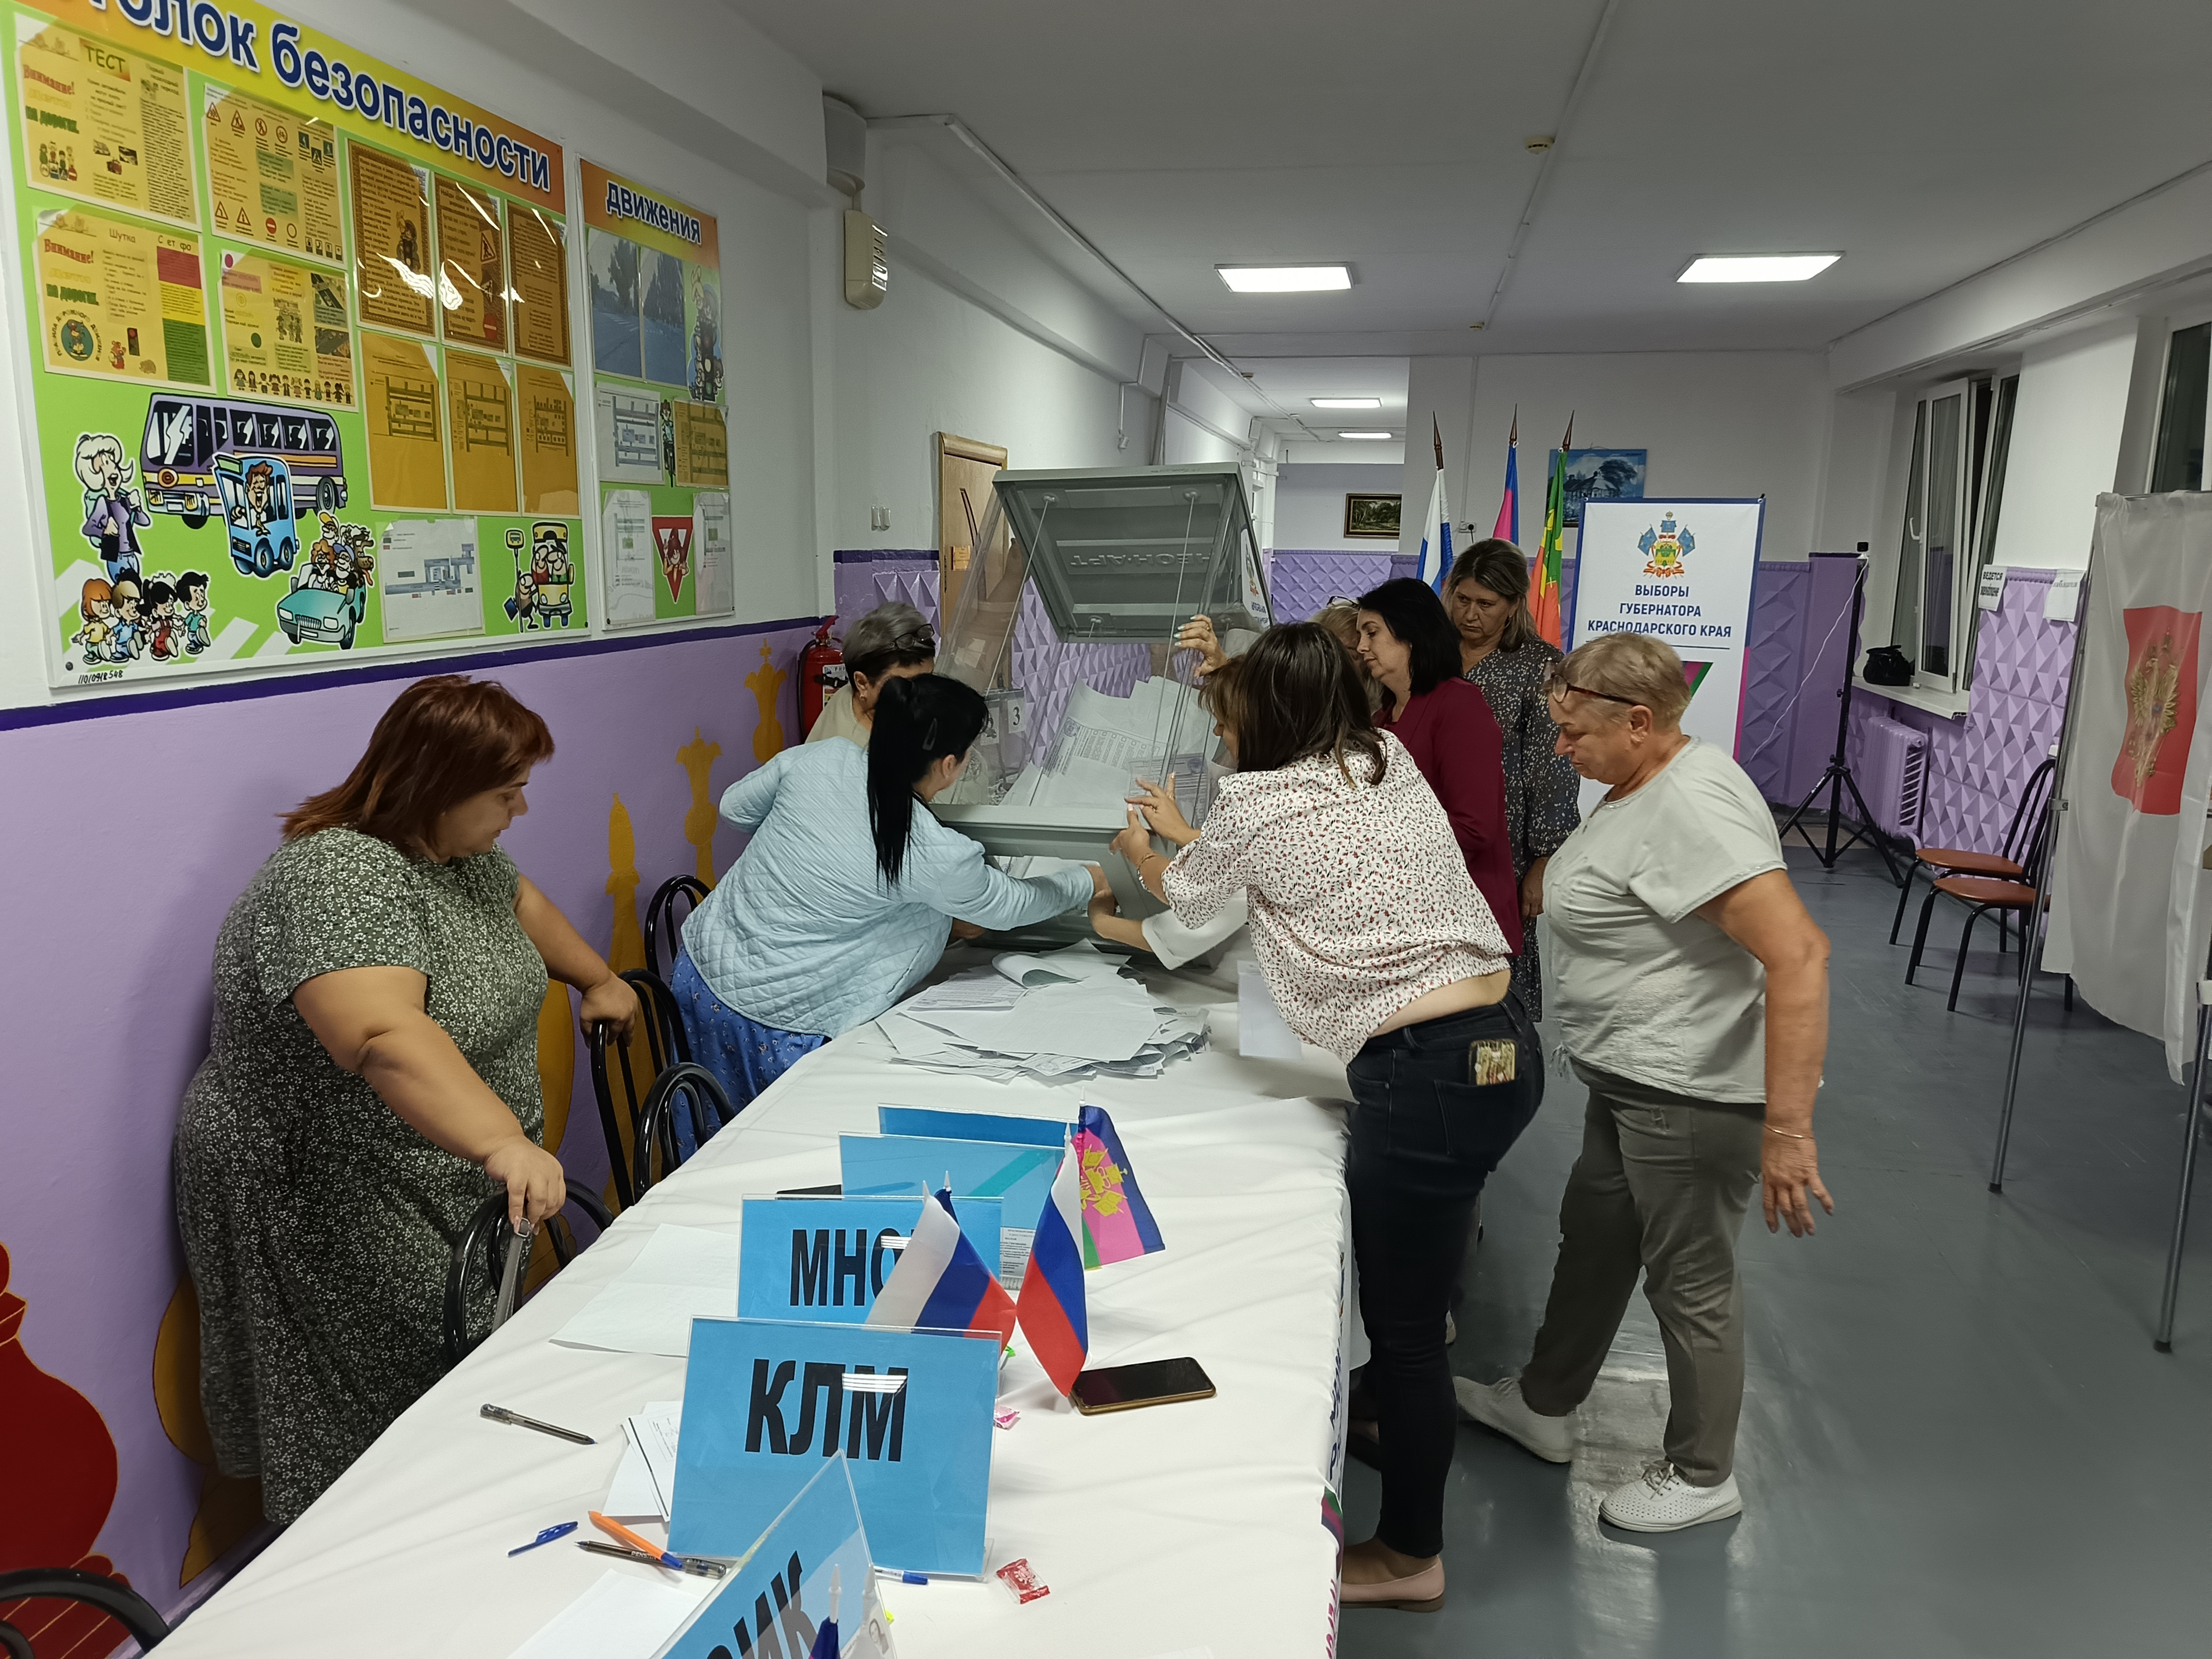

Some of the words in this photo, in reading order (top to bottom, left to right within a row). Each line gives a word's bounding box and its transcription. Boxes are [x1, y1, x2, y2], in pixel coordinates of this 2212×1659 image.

[84, 45, 126, 73] ТЕСТ
[88, 0, 259, 70] лок
[273, 24, 550, 190] безопасности
[607, 181, 701, 244] движения
[109, 229, 135, 242] Шутка
[44, 239, 94, 264] Внимание!
[1982, 571, 2003, 581] ВЕДЕТСЯ
[1635, 585, 1689, 597] ВЫБОРЫ
[1619, 603, 1701, 617] ГУБЕРНАТОРА
[1588, 620, 1697, 636] КРАСНОДАРСКОГО
[1700, 625, 1731, 638] КРАЯ
[1013, 706, 1020, 726] 3
[789, 1228, 914, 1306] МНО
[745, 1359, 909, 1462] КЛМ
